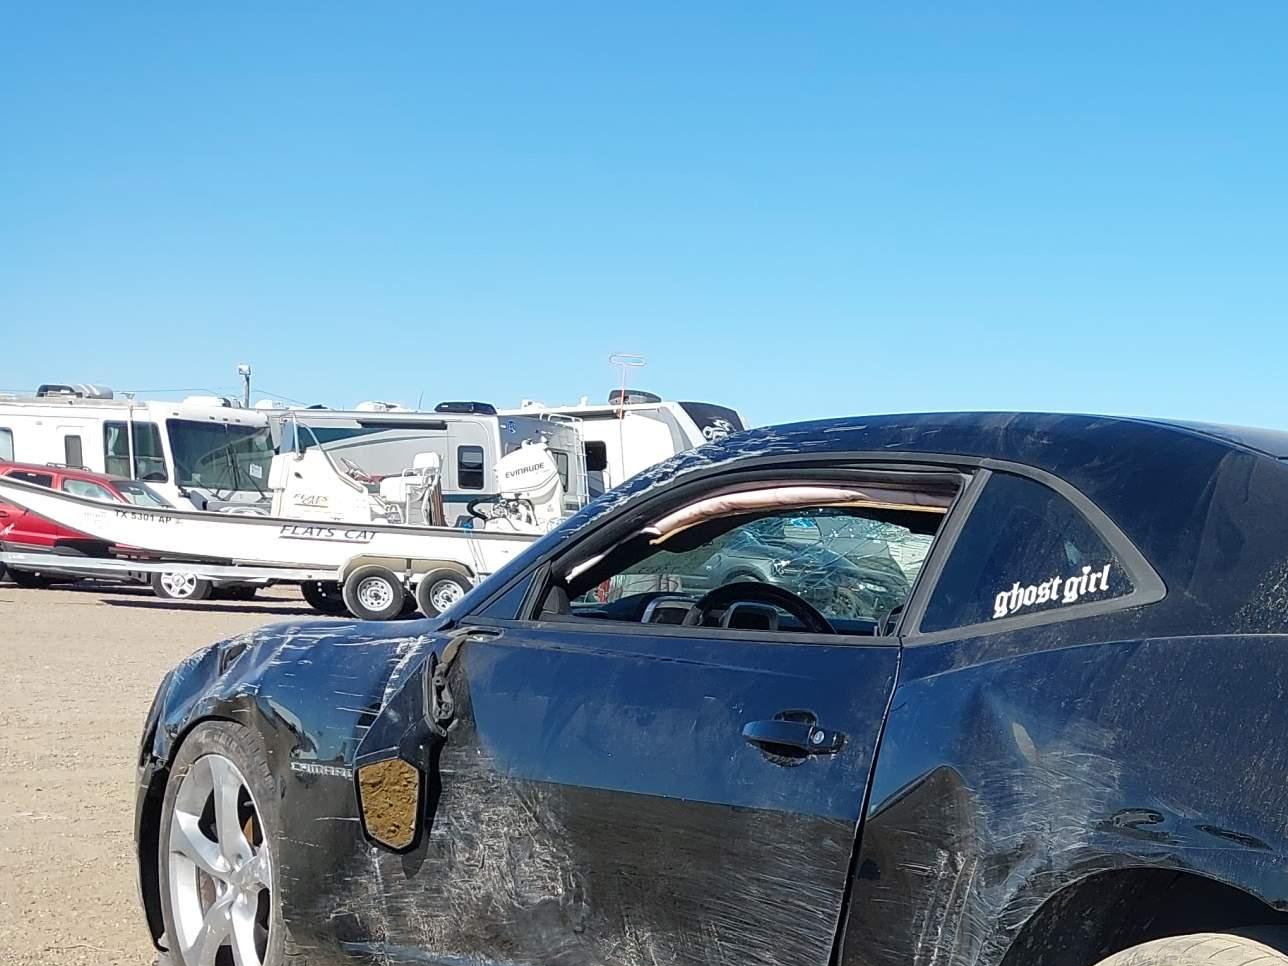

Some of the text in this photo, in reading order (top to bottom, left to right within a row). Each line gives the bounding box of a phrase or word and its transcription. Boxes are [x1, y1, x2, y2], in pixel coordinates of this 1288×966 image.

[505, 463, 545, 478] EVINRUDE
[115, 509, 128, 520] TX
[131, 511, 155, 523] 5301
[157, 515, 172, 525] AP
[280, 523, 379, 541] FLATS CAT
[992, 563, 1111, 619] ghost girl
